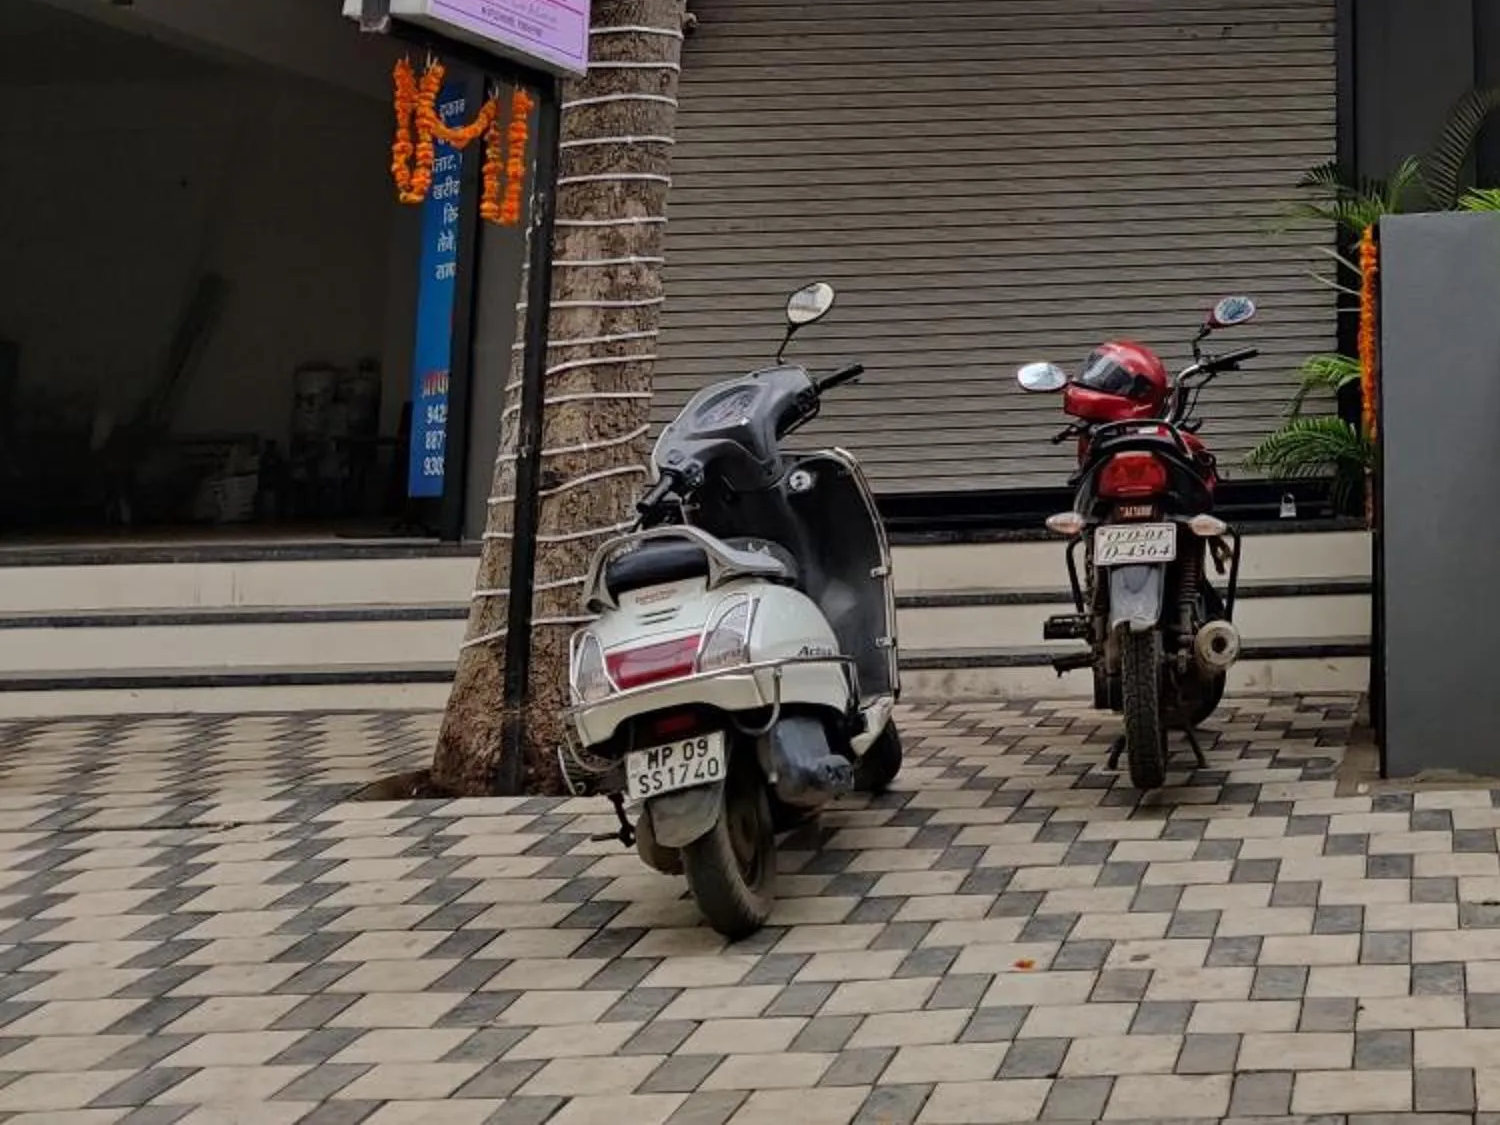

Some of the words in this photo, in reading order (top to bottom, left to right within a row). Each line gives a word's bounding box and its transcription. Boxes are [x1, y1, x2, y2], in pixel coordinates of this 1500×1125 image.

[647, 746, 673, 770] MP
[682, 738, 708, 761] 09
[638, 756, 719, 794] SS1740
